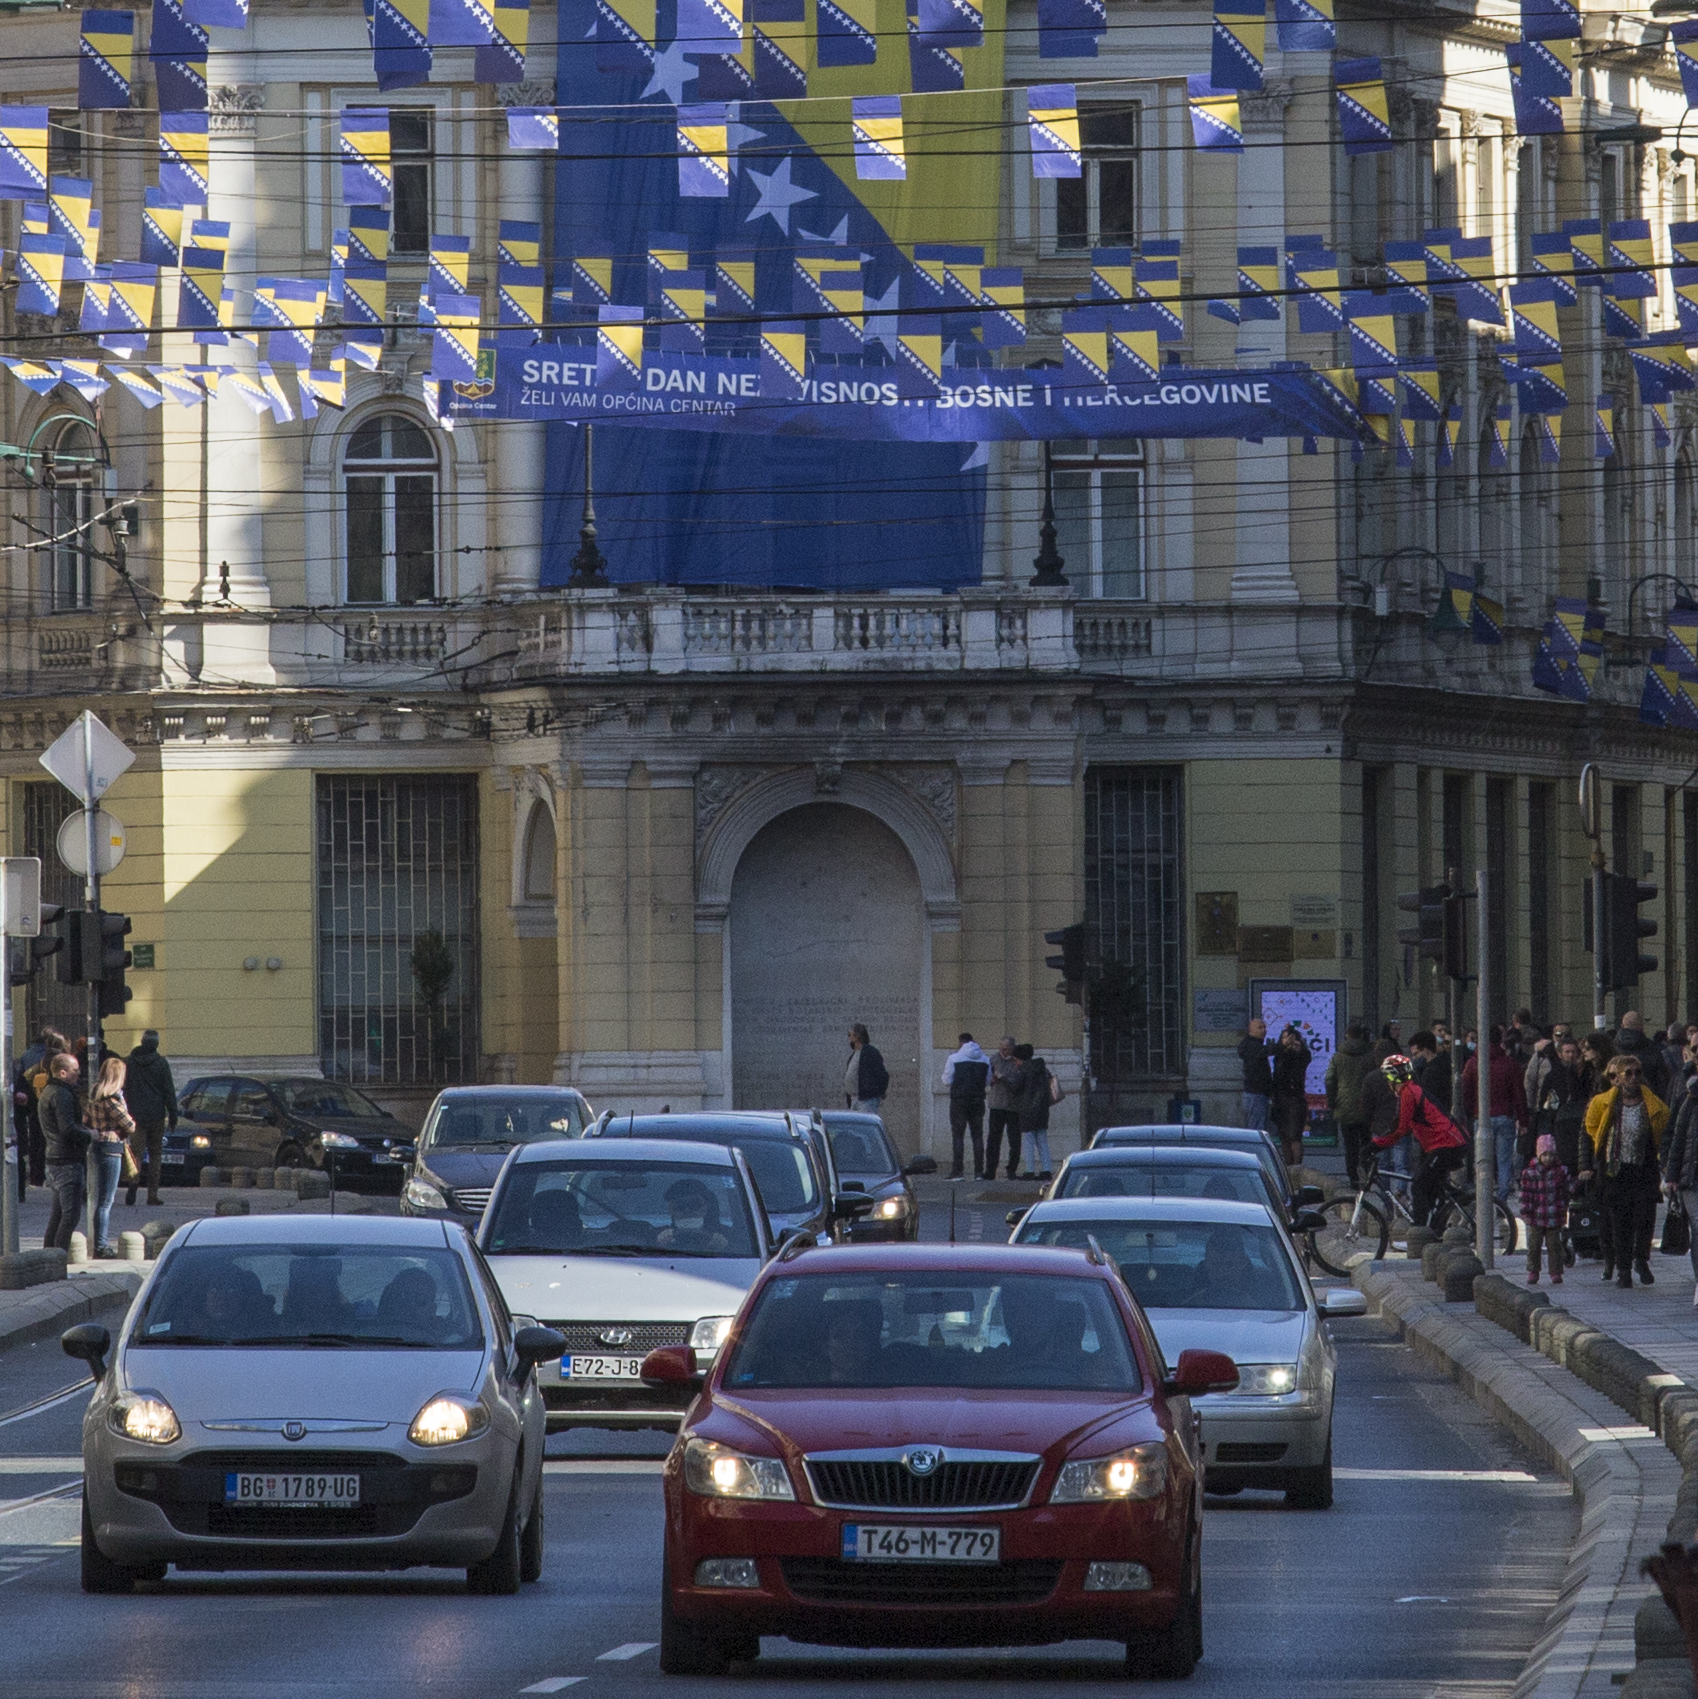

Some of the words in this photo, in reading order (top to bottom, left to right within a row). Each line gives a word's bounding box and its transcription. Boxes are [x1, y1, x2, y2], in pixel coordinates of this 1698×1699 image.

[522, 359, 598, 387] SRET
[646, 367, 706, 393] DAN
[935, 384, 1033, 408] BOSNE
[1045, 384, 1052, 406] I
[520, 387, 555, 406] ŽELI
[560, 391, 597, 407] VAM
[603, 391, 664, 412] OPĆINA
[670, 399, 736, 416] CENTAR
[241, 1476, 264, 1497] BG
[862, 1529, 995, 1557] T46-M-779
